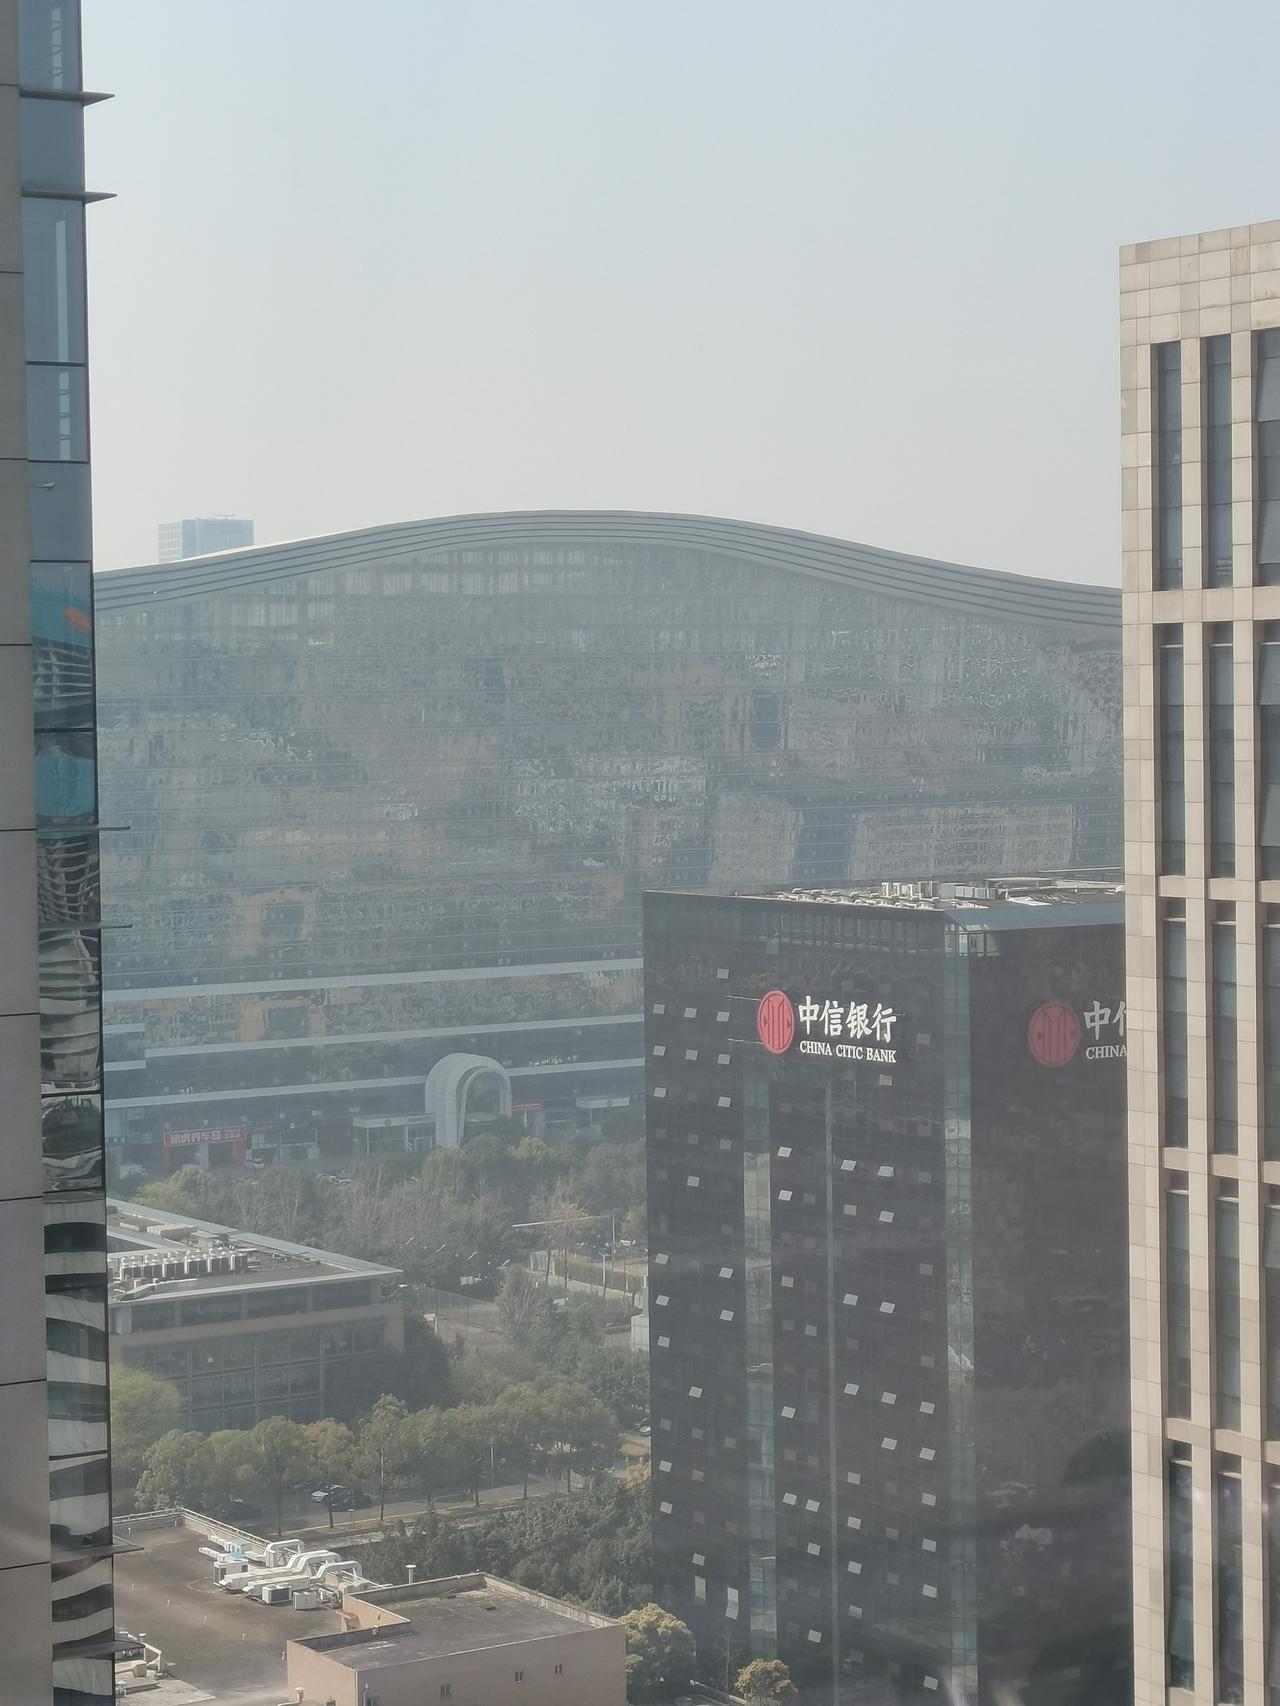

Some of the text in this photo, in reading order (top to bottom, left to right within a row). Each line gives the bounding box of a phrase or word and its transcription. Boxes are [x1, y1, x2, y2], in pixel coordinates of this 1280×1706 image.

[798, 994, 897, 1042] 中信银行
[799, 1040, 897, 1063] CHINA CITIC BANK
[1086, 1045, 1127, 1059] CHINA
